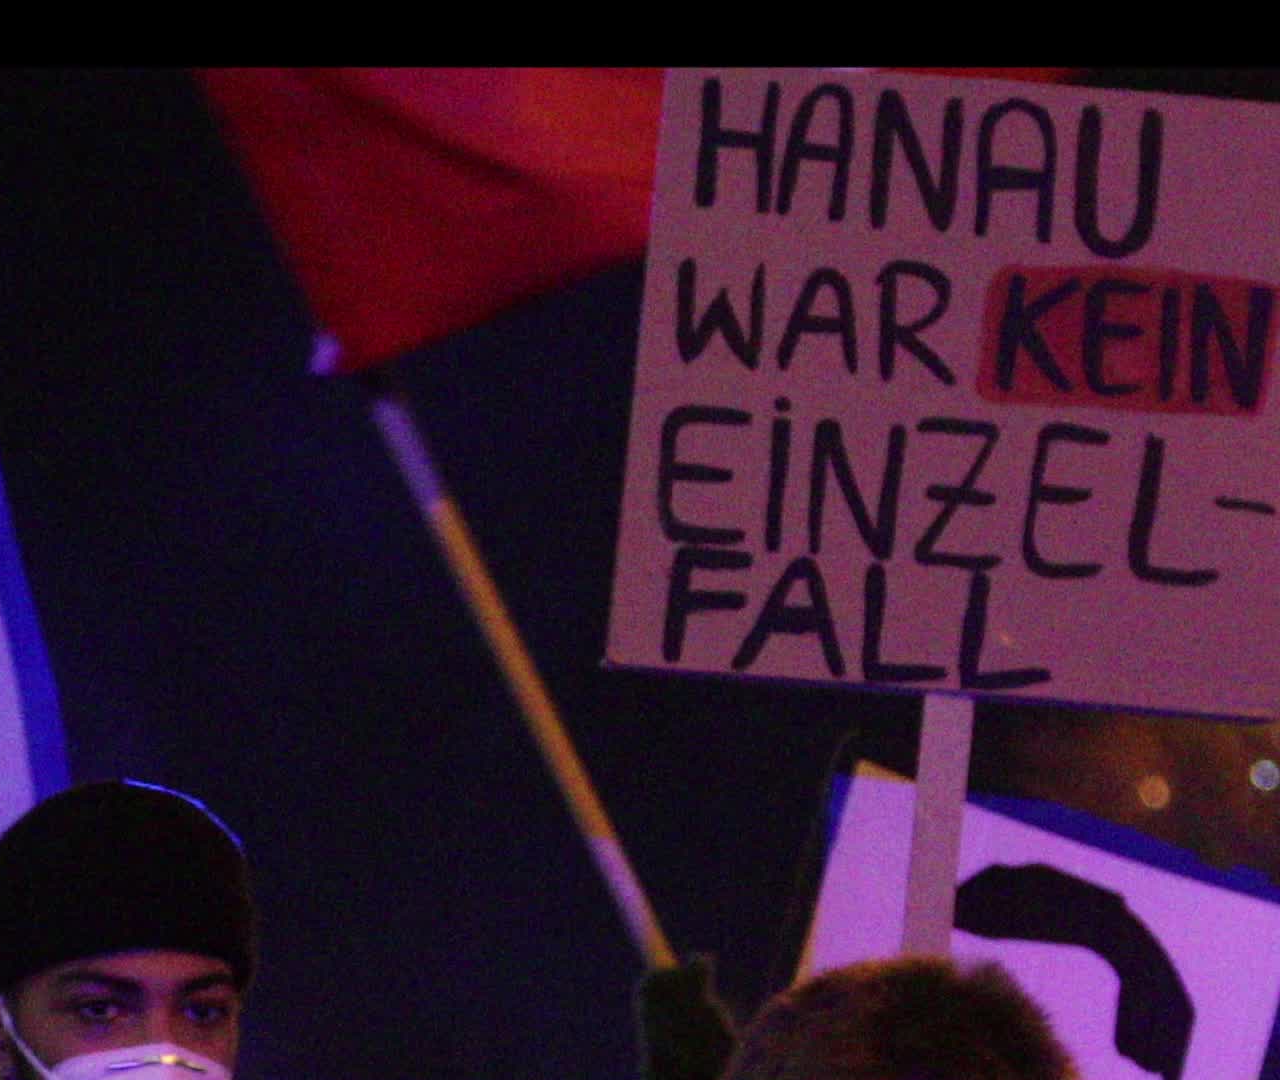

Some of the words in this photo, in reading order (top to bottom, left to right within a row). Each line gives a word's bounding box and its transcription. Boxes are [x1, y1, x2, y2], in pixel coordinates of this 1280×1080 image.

[694, 77, 1165, 259] HANAU
[676, 257, 955, 386] WAR
[996, 274, 1275, 411] KEIN
[664, 542, 1051, 690] FALL
